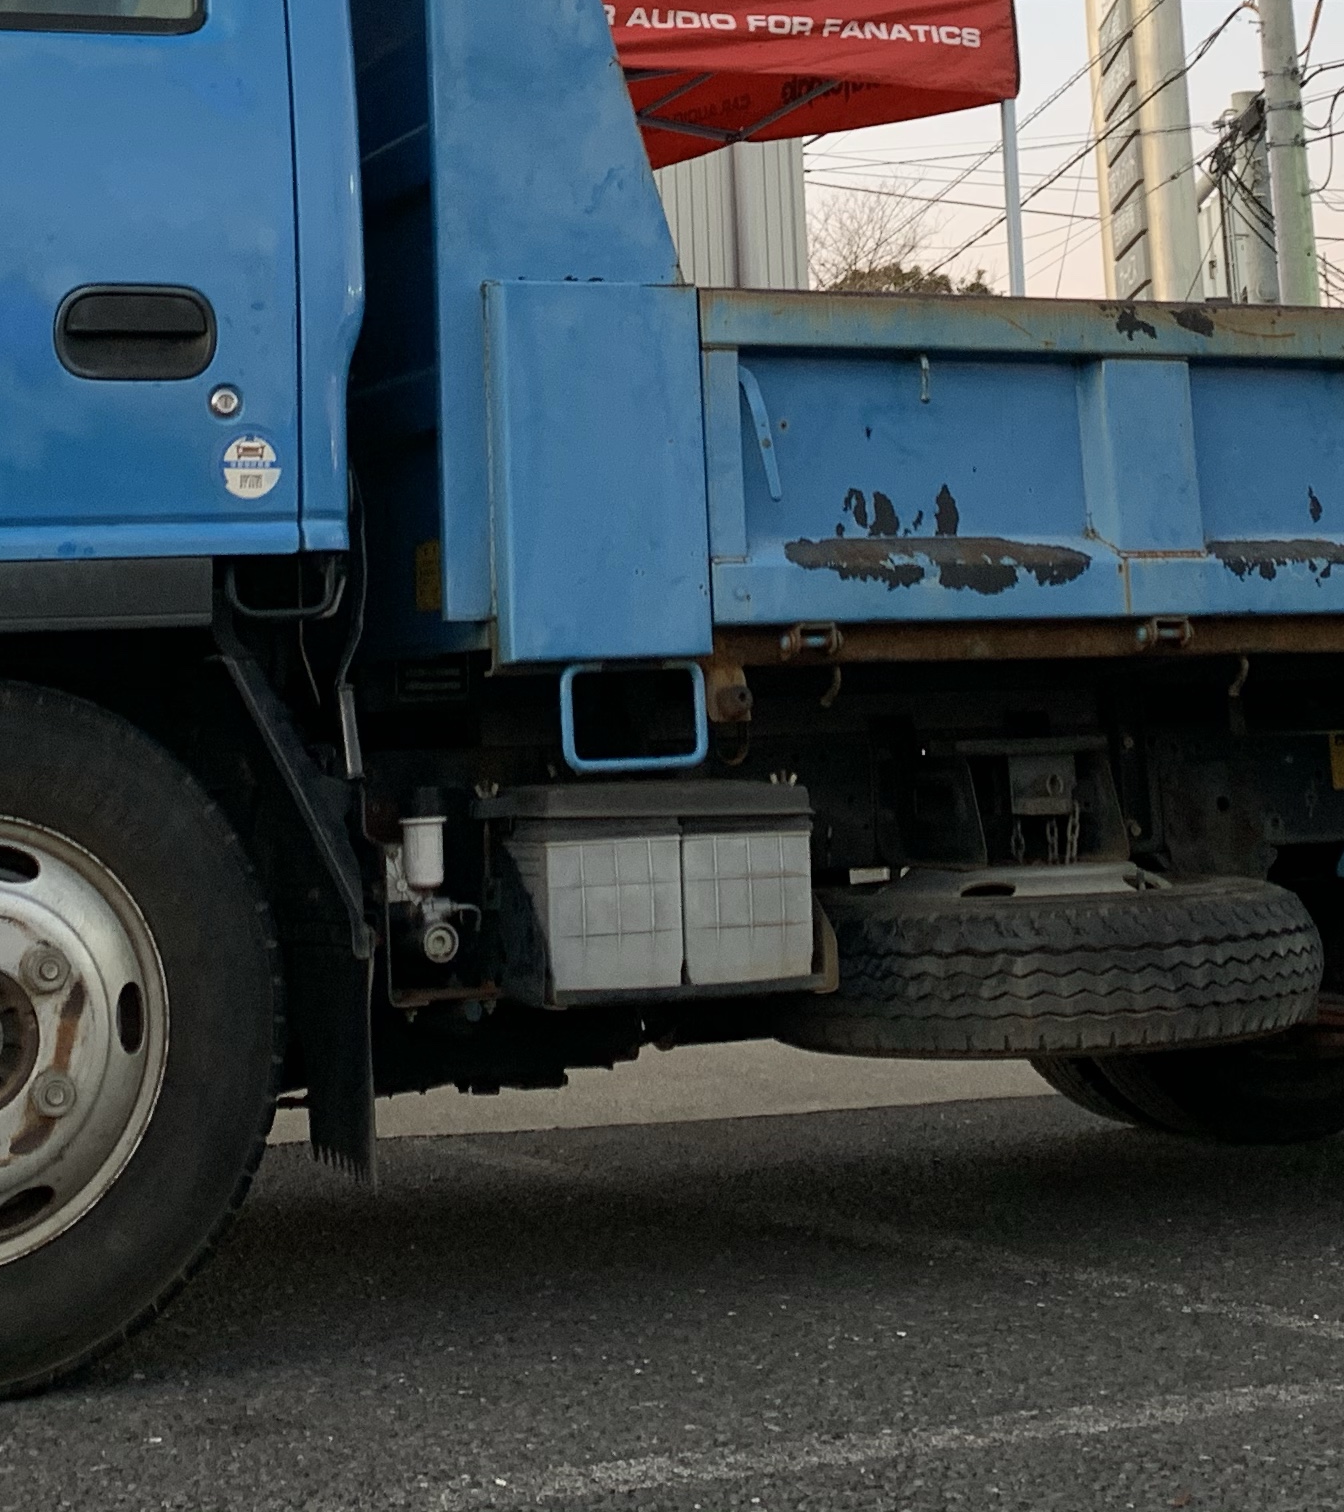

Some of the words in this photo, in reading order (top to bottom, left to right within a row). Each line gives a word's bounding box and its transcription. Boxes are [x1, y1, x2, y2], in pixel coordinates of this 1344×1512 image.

[625, 6, 737, 32] AUDIO
[746, 14, 813, 37] FOR
[822, 18, 983, 48] FANATICS
